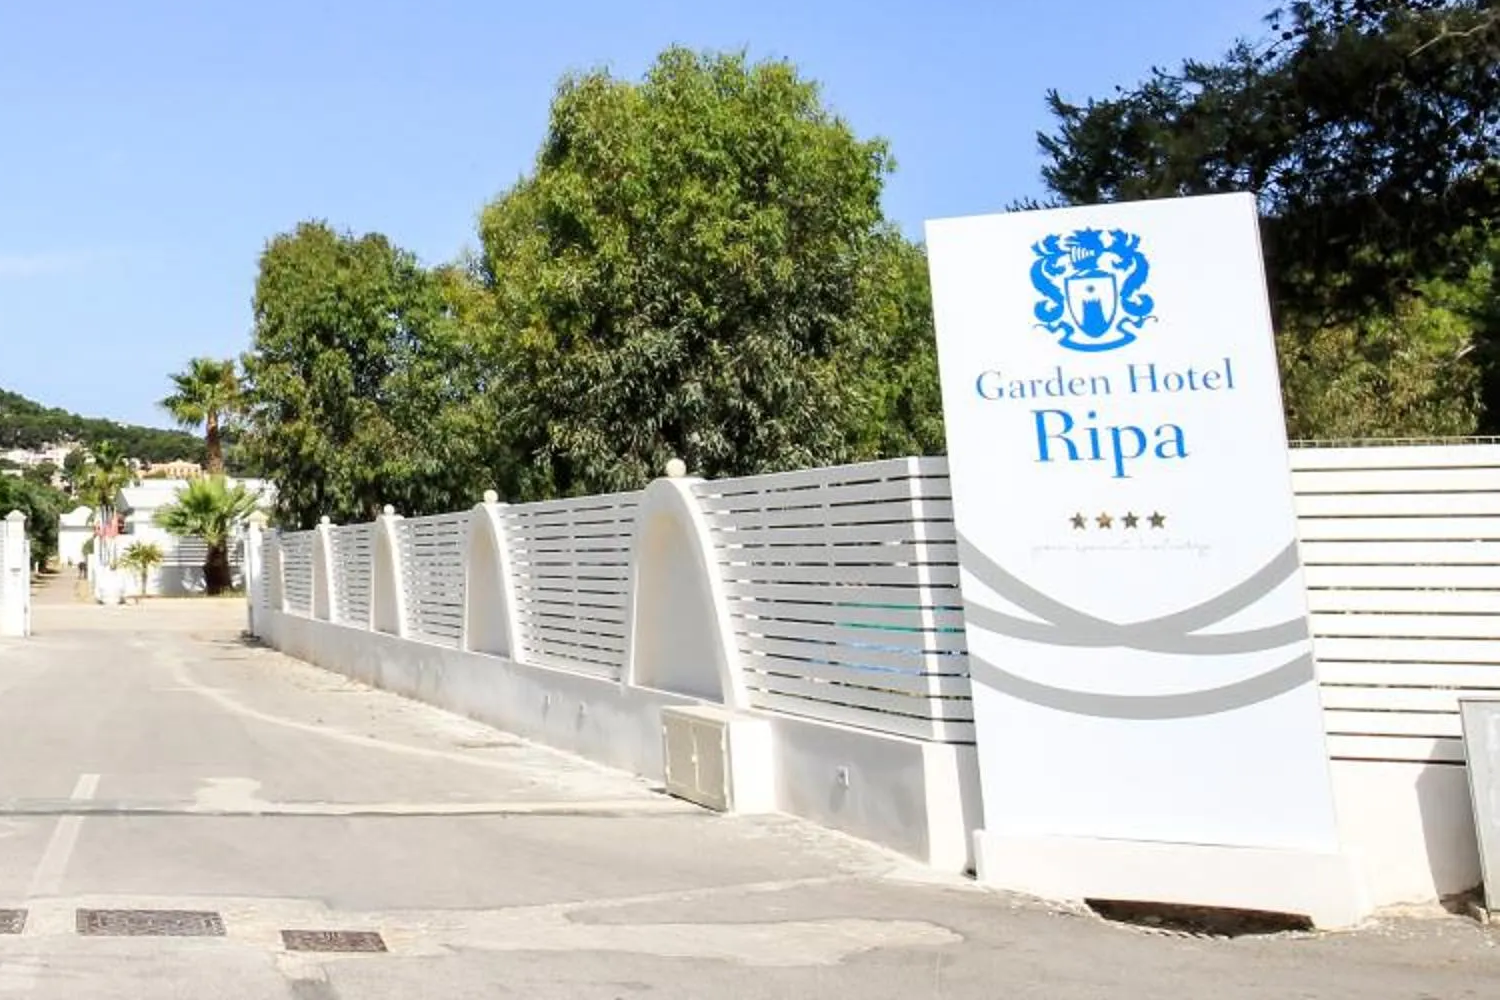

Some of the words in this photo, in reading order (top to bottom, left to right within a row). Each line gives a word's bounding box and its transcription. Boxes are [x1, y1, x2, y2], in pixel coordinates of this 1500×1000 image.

[975, 365, 1112, 401] Garden
[1127, 357, 1235, 394] Hotel
[1029, 408, 1190, 480] Ripa
